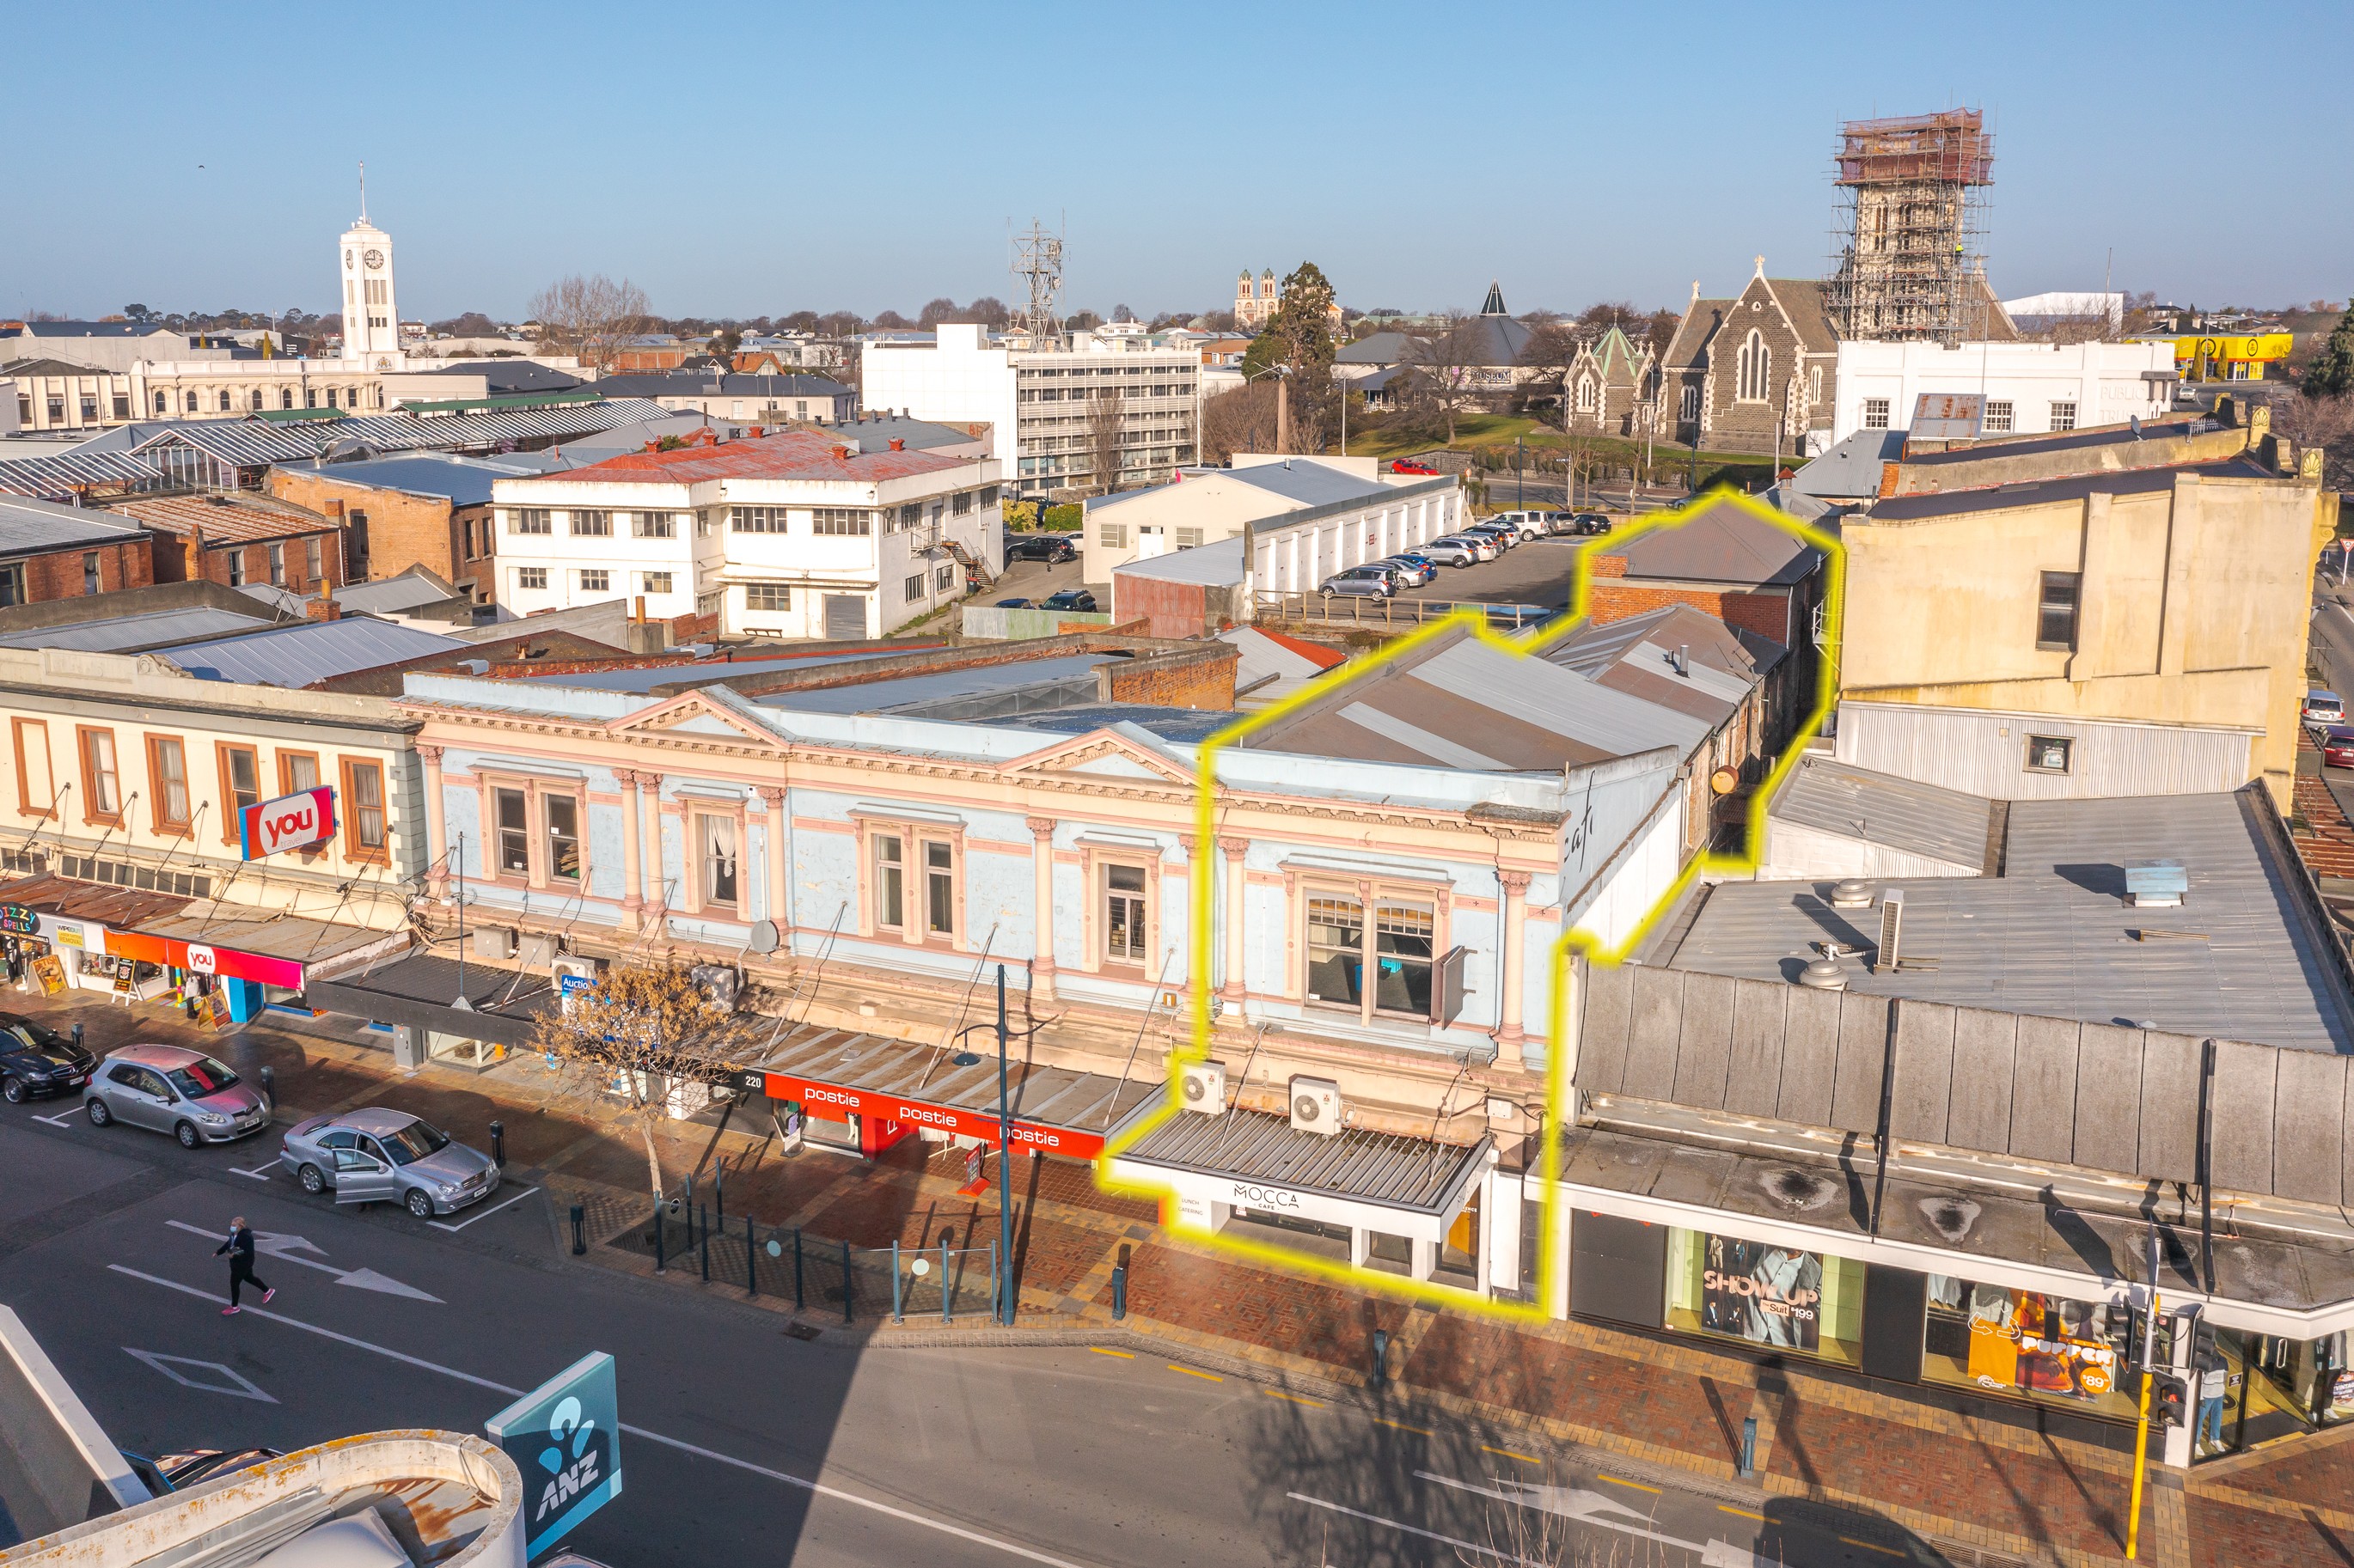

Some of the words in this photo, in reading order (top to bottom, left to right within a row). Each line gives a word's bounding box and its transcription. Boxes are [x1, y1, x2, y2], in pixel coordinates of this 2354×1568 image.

[2100, 386, 2145, 400] PUBLIC
[2100, 409, 2144, 423] TRUST
[265, 808, 313, 848] you
[280, 833, 303, 849] travel
[3, 919, 31, 931] SPELLS
[58, 937, 83, 946] REMOVAL
[190, 951, 213, 967] you
[563, 978, 590, 990] Auctio
[745, 1075, 762, 1089] 220
[804, 1087, 860, 1107] postie
[899, 1106, 957, 1127] postie
[1181, 1198, 1200, 1206] LUNCH
[1234, 1184, 1299, 1209] MOCCA
[1177, 1206, 1204, 1216] CATERING
[1703, 1270, 1780, 1300] SHOW
[1782, 1285, 1819, 1307] UP
[1770, 1303, 1788, 1315] Suit
[1790, 1306, 1814, 1321] $199
[2022, 1336, 2113, 1365] PUFFER
[536, 1450, 599, 1522] ANZ
